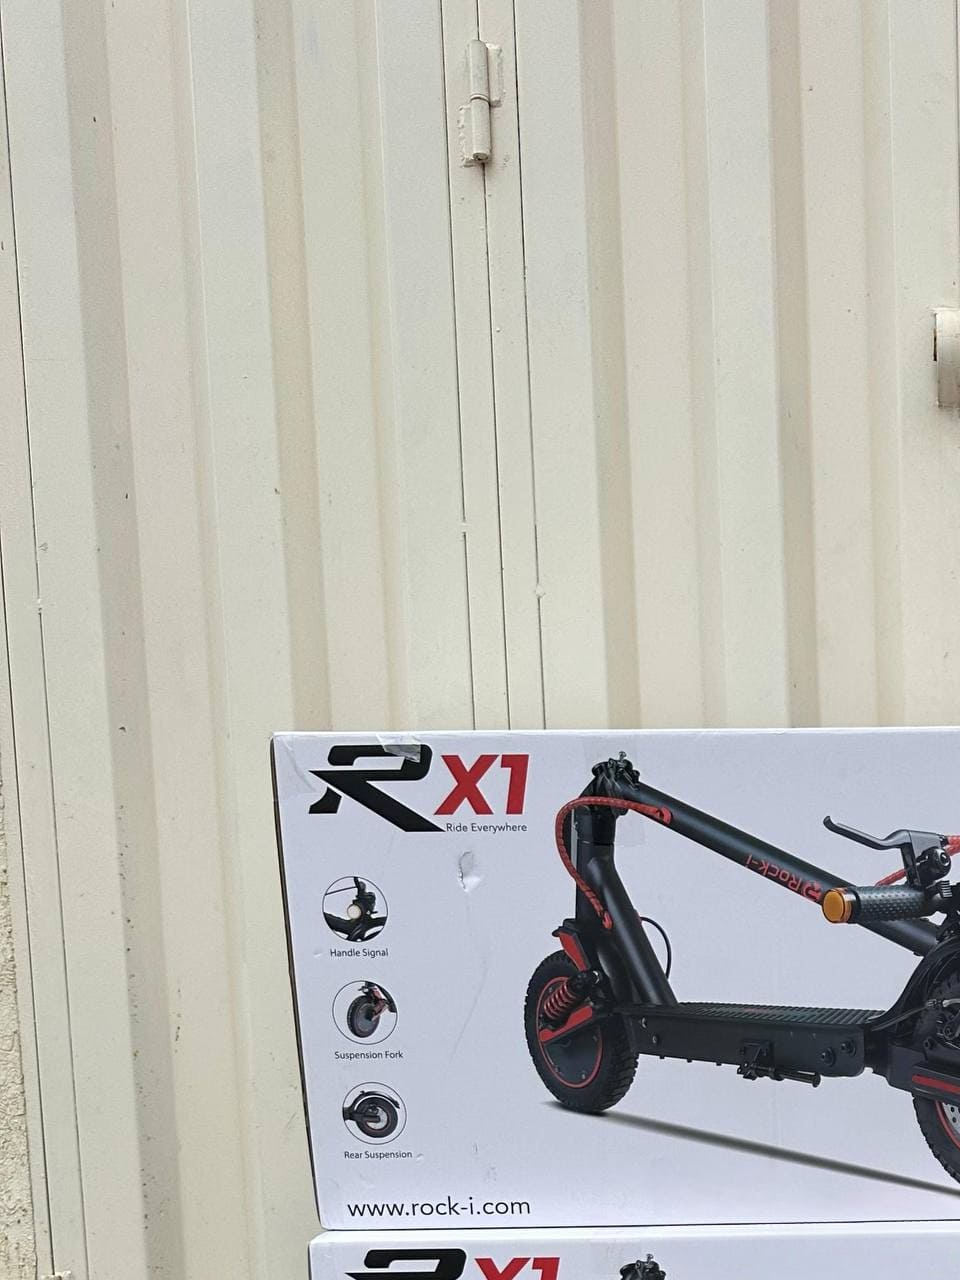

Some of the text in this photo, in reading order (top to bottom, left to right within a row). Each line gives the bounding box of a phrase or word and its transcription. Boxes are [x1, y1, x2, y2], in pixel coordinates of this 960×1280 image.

[446, 823, 528, 834] Ride Everywhere
[330, 948, 389, 958] Handle Signal
[334, 1050, 404, 1061] Suspension Fork
[344, 1150, 413, 1161] Rear Suspension
[347, 1196, 531, 1217] www.rock-i.com
